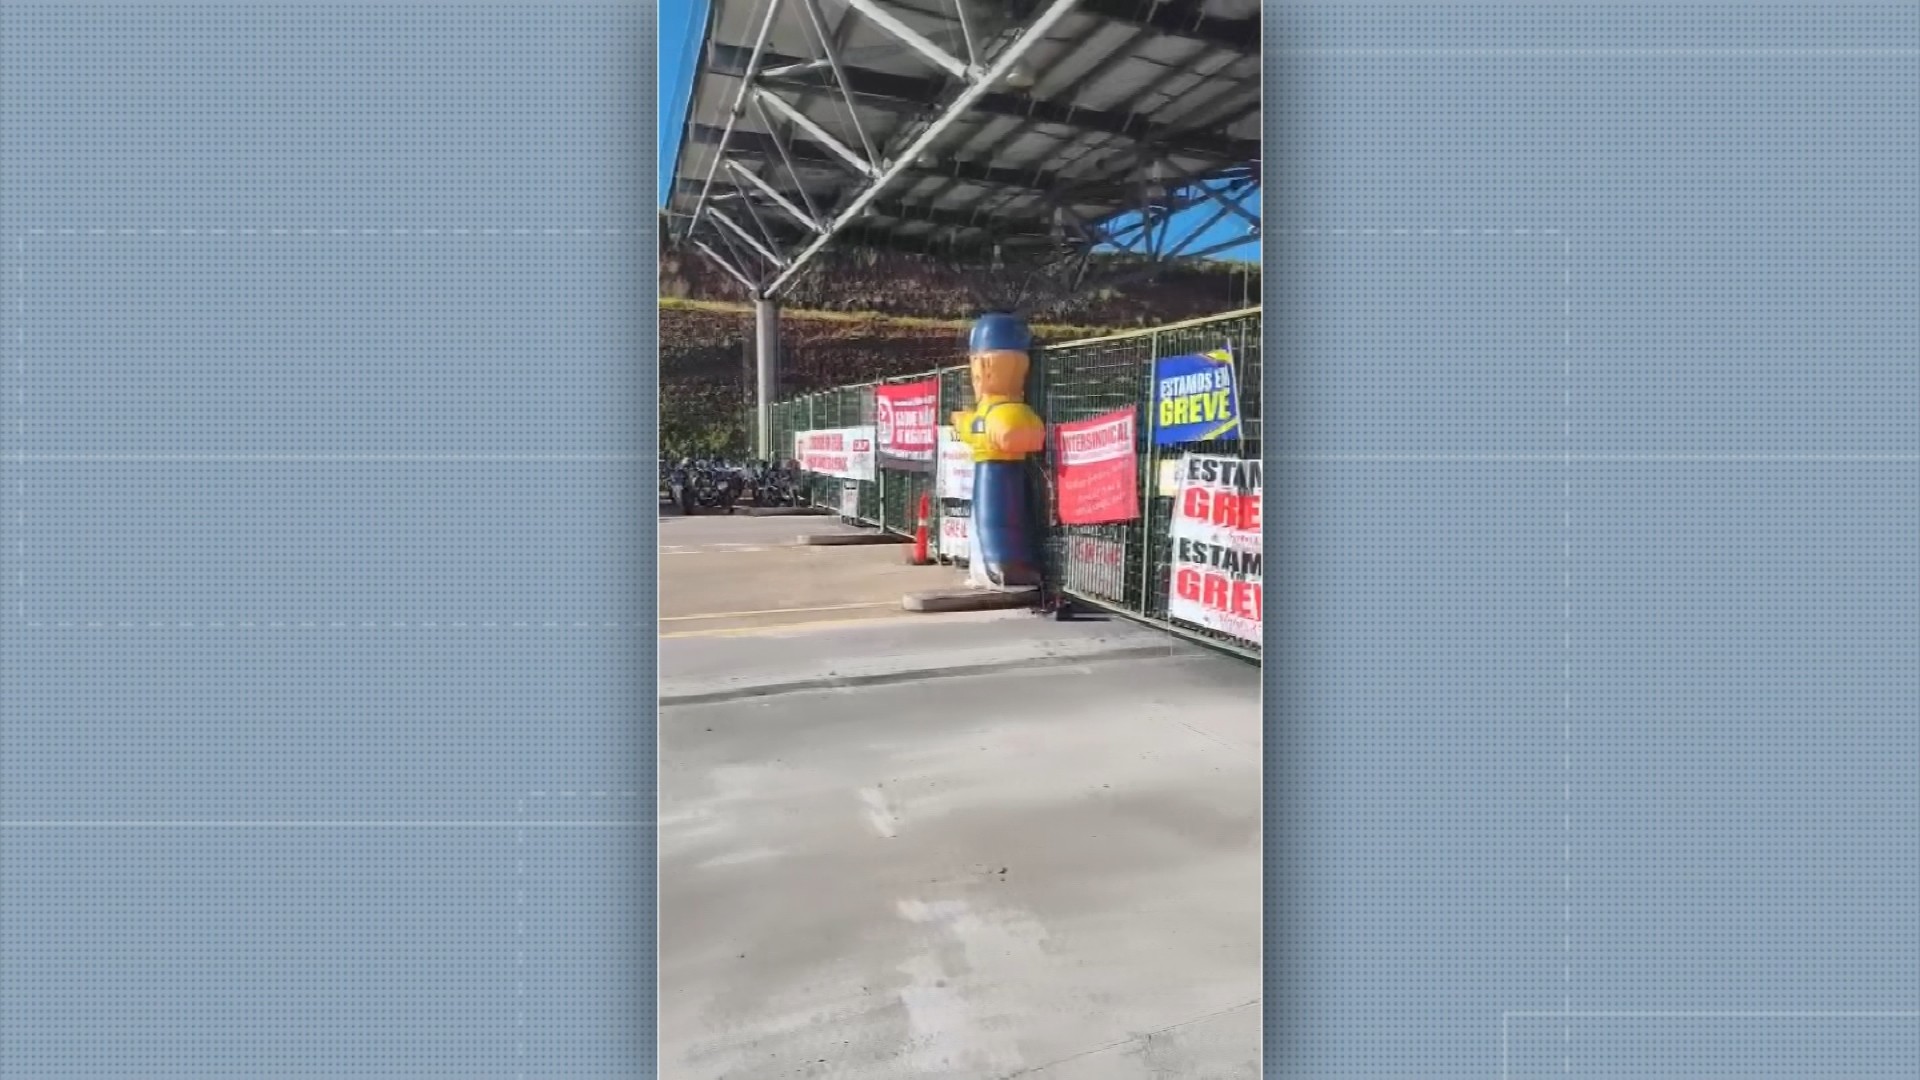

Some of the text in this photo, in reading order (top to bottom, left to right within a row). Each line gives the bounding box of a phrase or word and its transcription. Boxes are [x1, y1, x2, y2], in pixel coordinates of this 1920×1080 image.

[1160, 372, 1212, 398] ESTAMOS
[1160, 388, 1231, 427] GREVE
[1062, 421, 1129, 453] INTERSINDICAL
